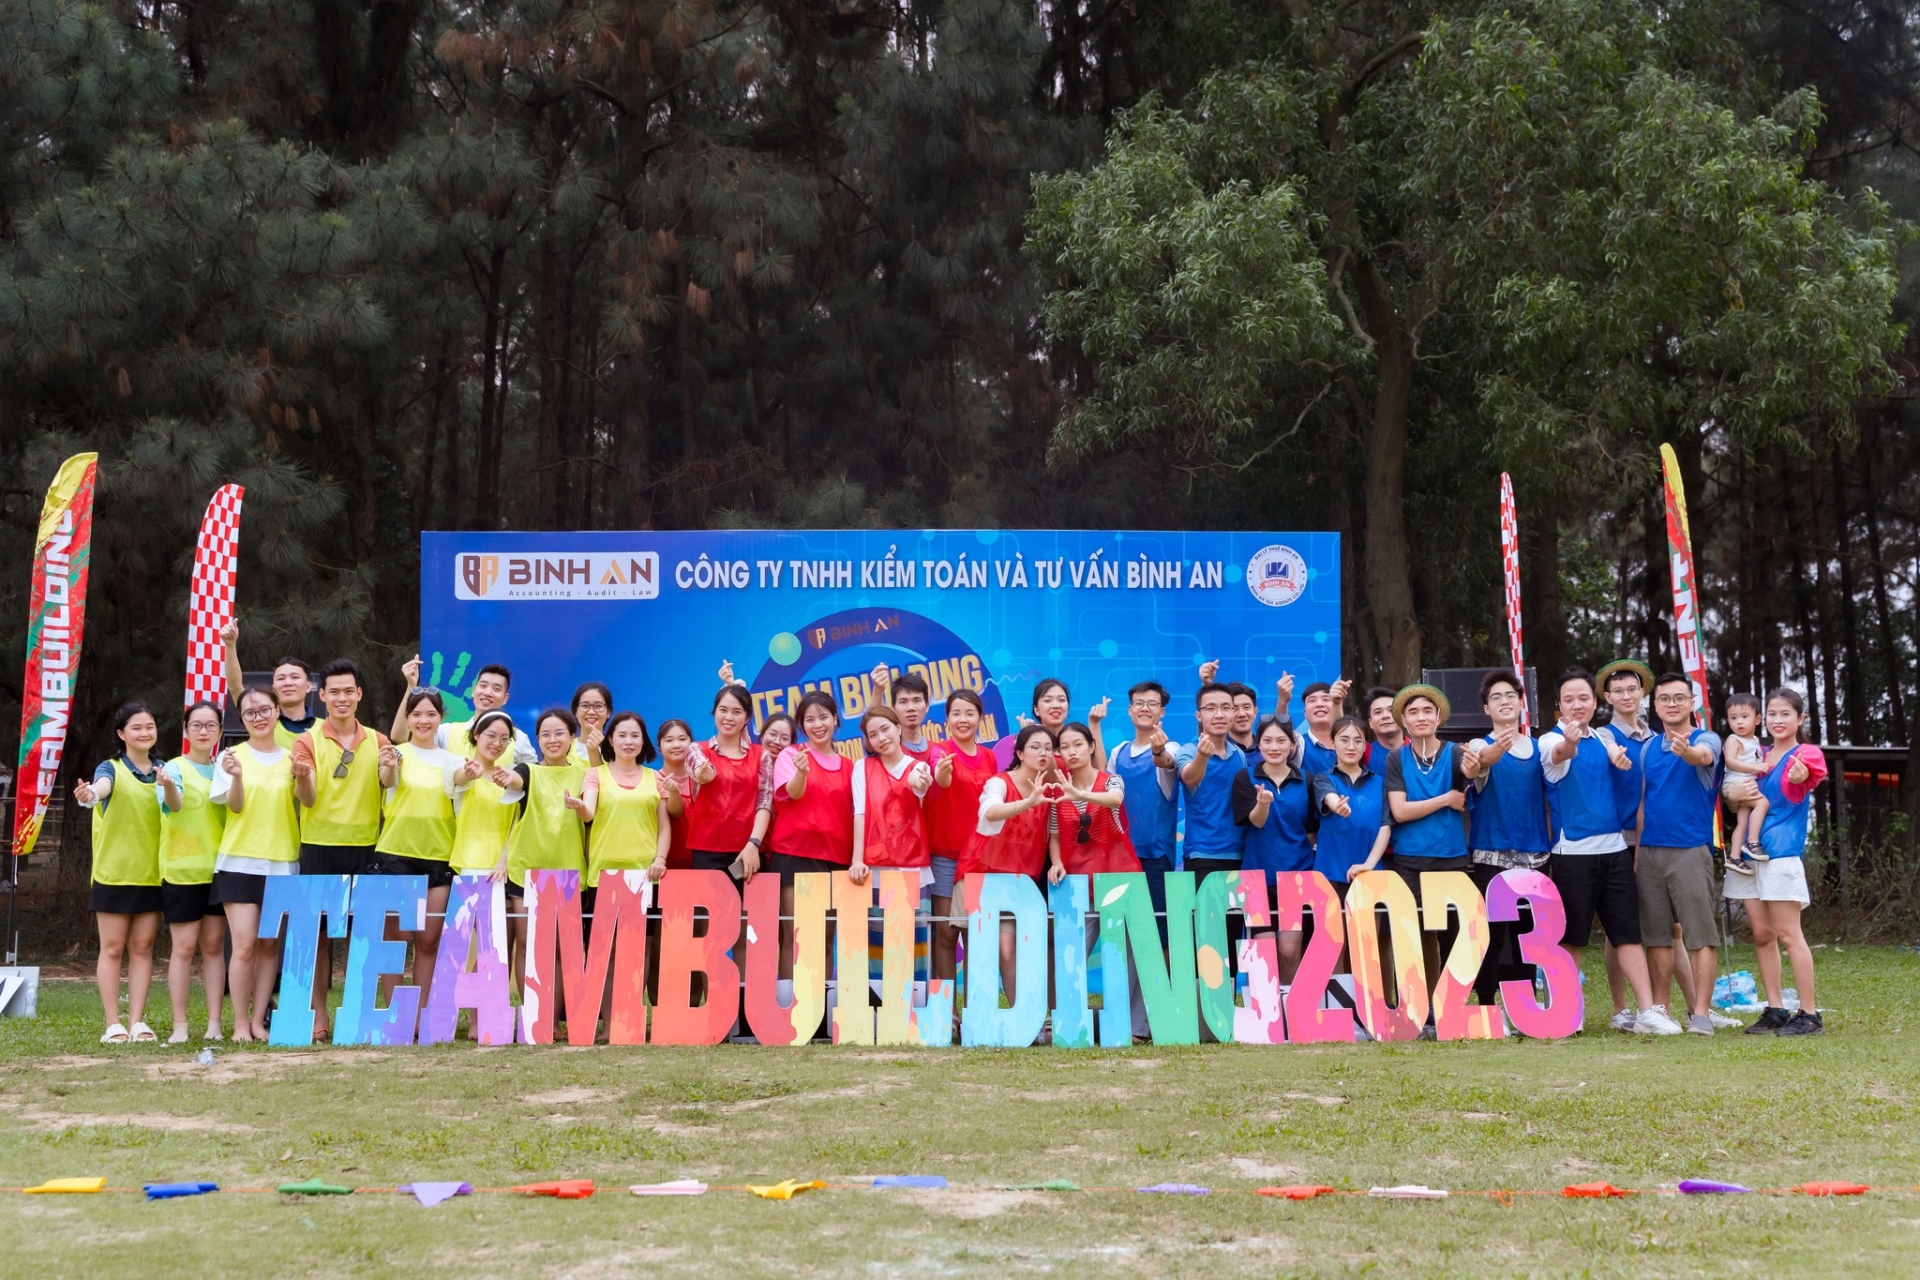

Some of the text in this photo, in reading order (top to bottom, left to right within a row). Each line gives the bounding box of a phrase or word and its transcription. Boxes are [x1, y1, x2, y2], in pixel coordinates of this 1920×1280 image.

[509, 558, 652, 585] BINH AN
[675, 544, 1222, 589] CÔNG TY TNHH KIỂM TOÁN VÀ TƯ VẤN BÌNH AN
[840, 654, 983, 716] BIDING
